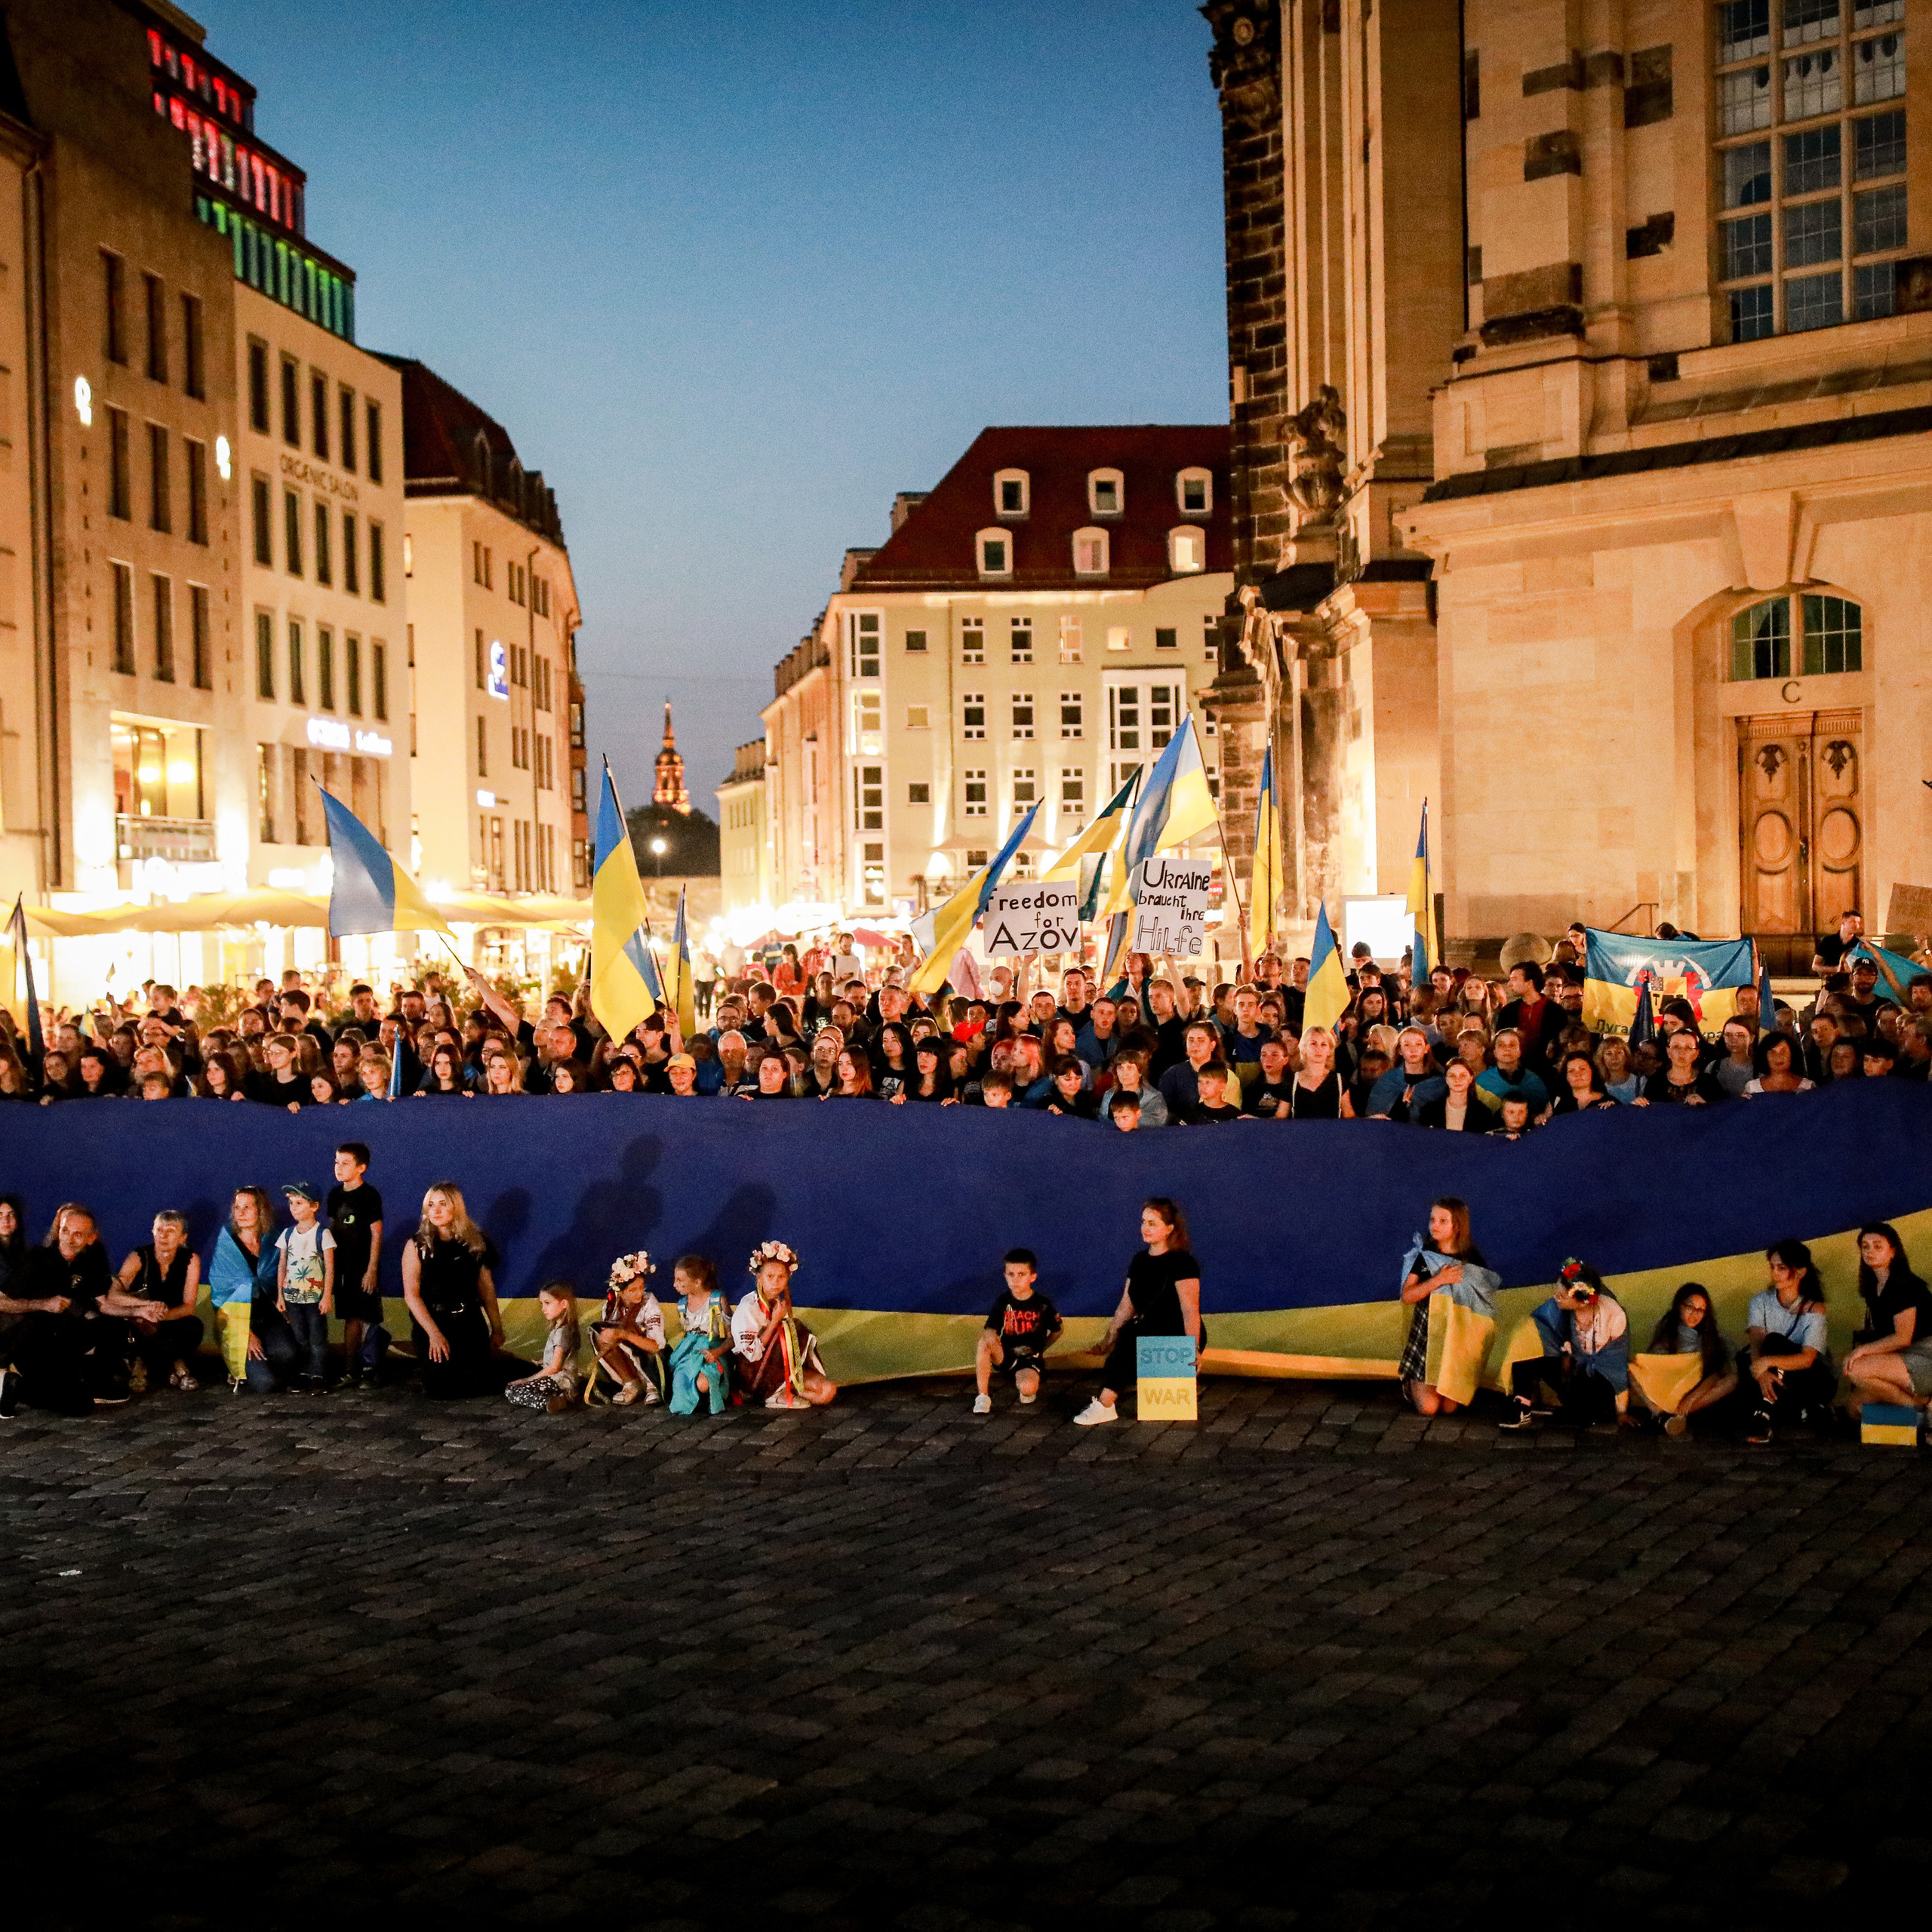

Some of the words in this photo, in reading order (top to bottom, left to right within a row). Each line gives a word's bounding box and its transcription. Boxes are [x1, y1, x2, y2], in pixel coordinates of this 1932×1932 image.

[1782, 681, 1800, 703] C
[1138, 890, 1188, 908] braucht
[1034, 911, 1064, 928] for
[1180, 908, 1205, 921] ihre
[1140, 1347, 1193, 1364] STOP
[1143, 1388, 1192, 1405] WAR
